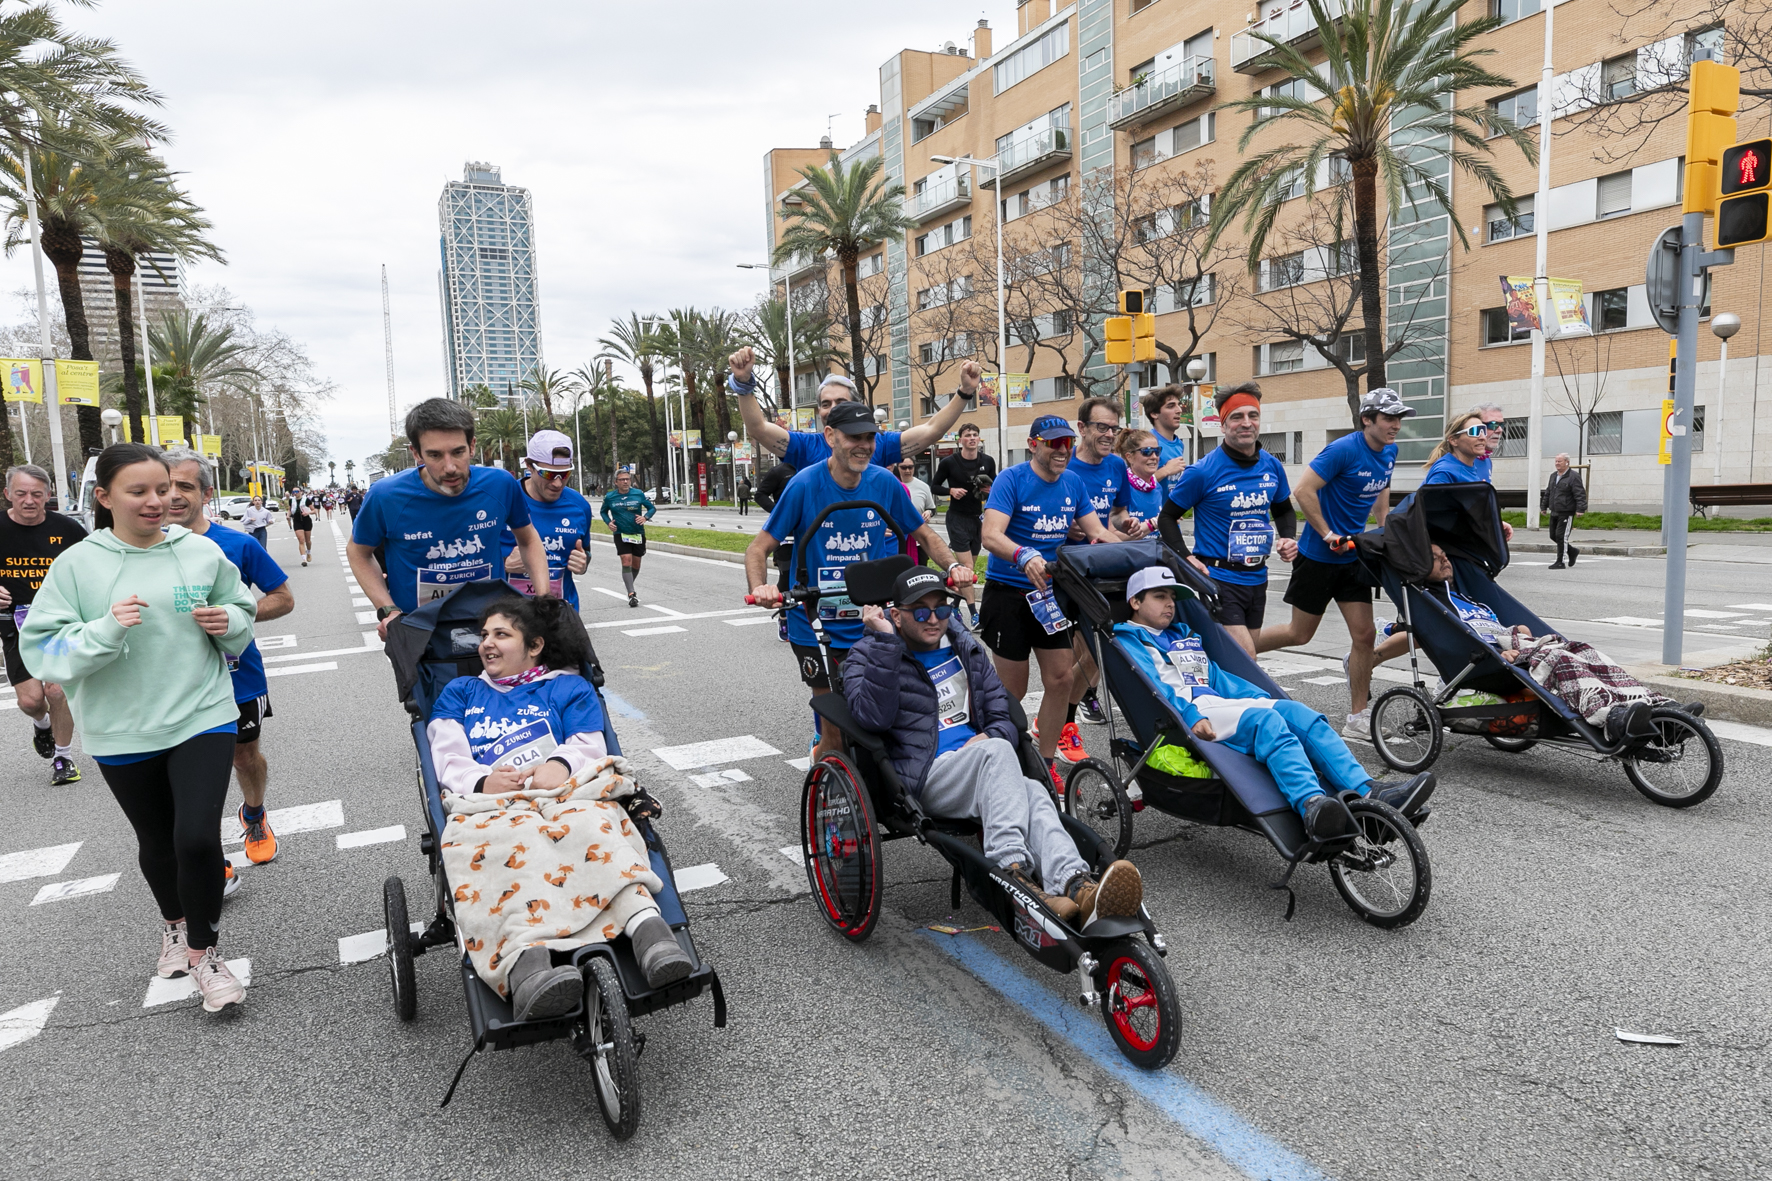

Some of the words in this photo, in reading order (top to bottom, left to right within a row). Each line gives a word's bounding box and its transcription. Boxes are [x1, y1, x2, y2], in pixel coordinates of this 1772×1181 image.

[468, 519, 497, 532] ZURICH
[49, 536, 63, 544] PT
[404, 531, 433, 540] aefat
[1236, 534, 1267, 545] HÉCTOR
[6, 557, 57, 566] SUICID
[449, 572, 476, 580] ZURICH
[505, 729, 532, 747] ZURICH
[505, 749, 541, 767] OLA
